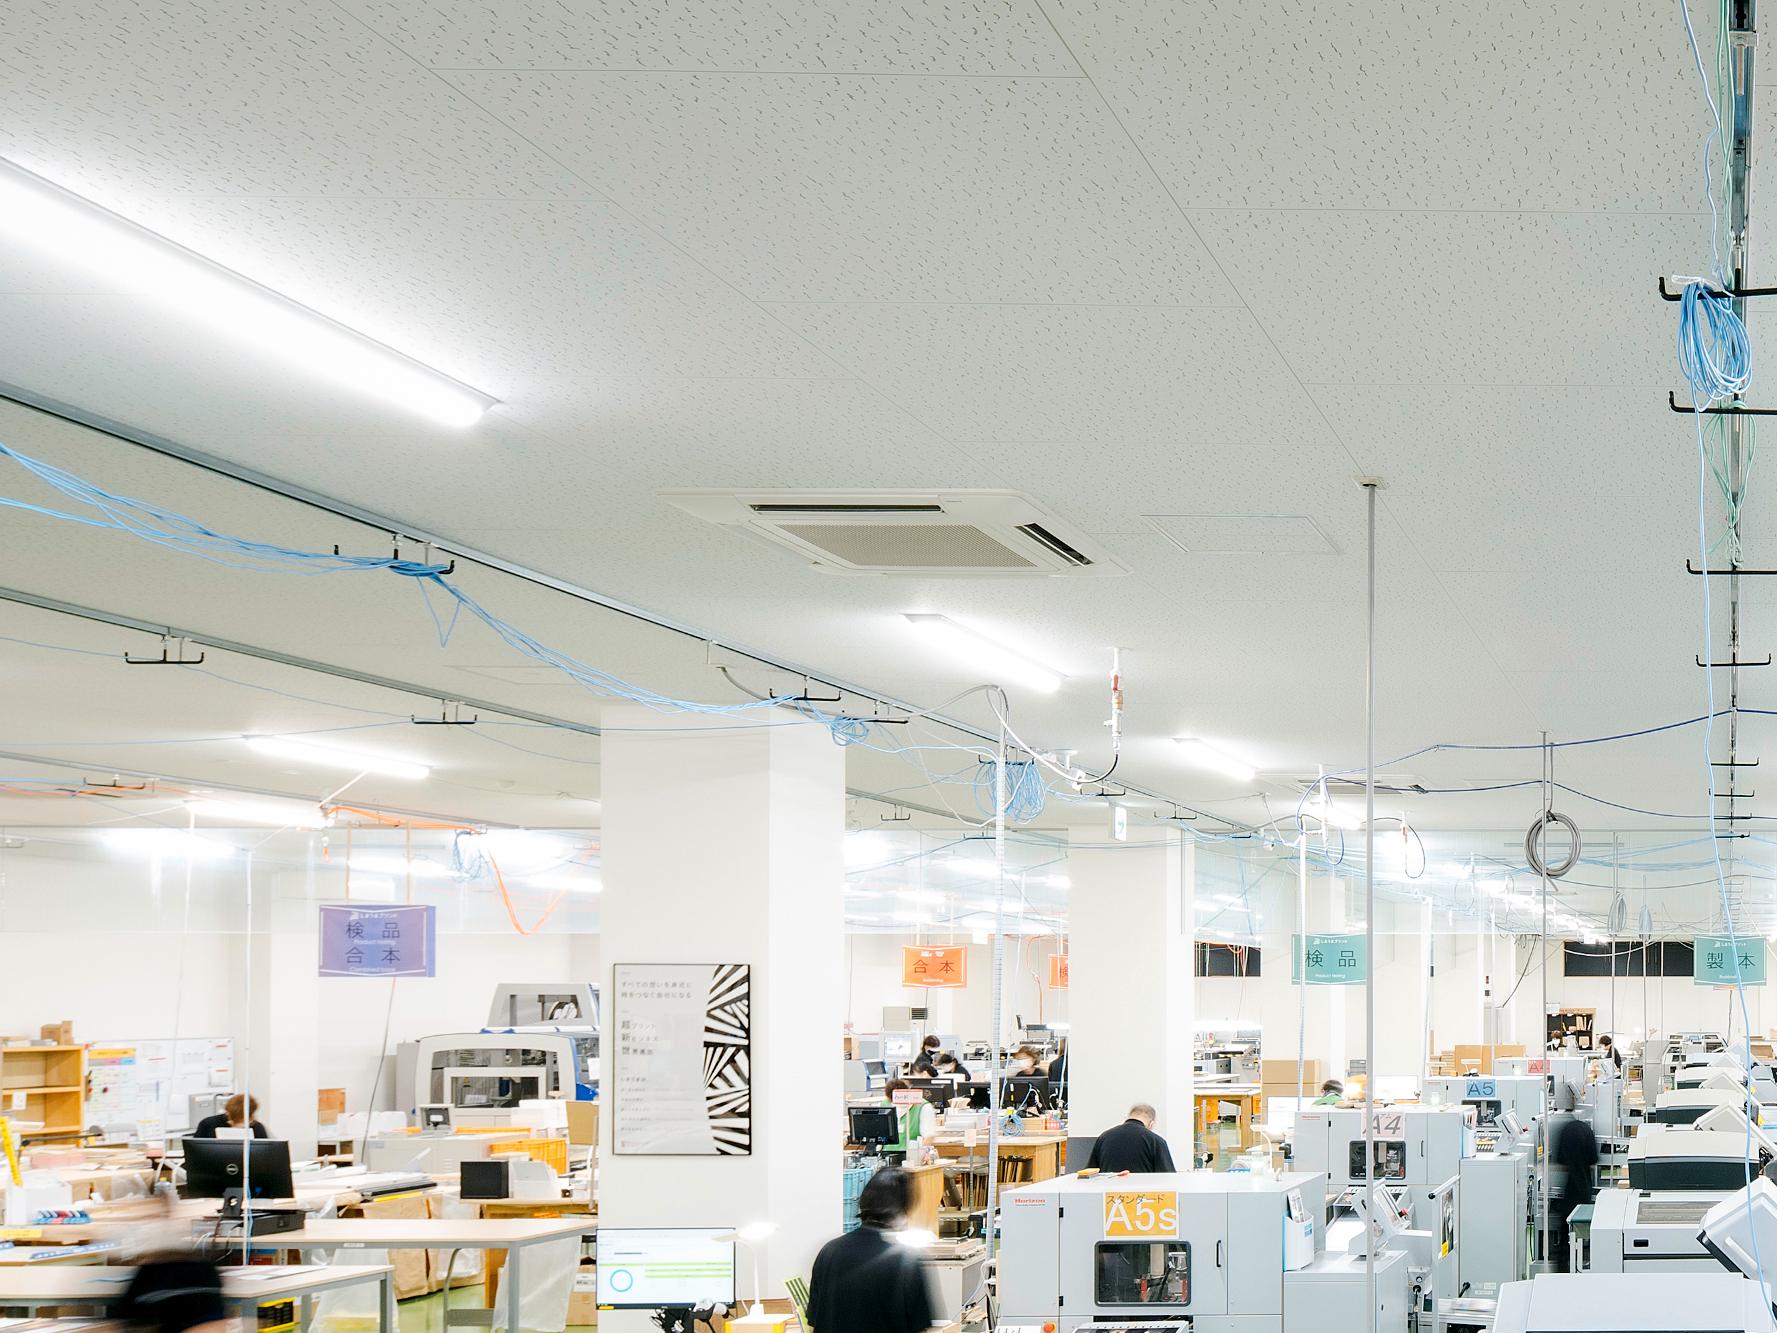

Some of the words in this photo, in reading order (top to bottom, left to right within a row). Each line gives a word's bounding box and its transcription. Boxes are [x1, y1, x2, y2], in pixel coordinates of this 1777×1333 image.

[1467, 1082, 1493, 1096] A5
[1362, 1115, 1402, 1134] A4
[1105, 1199, 1177, 1231] A5s
